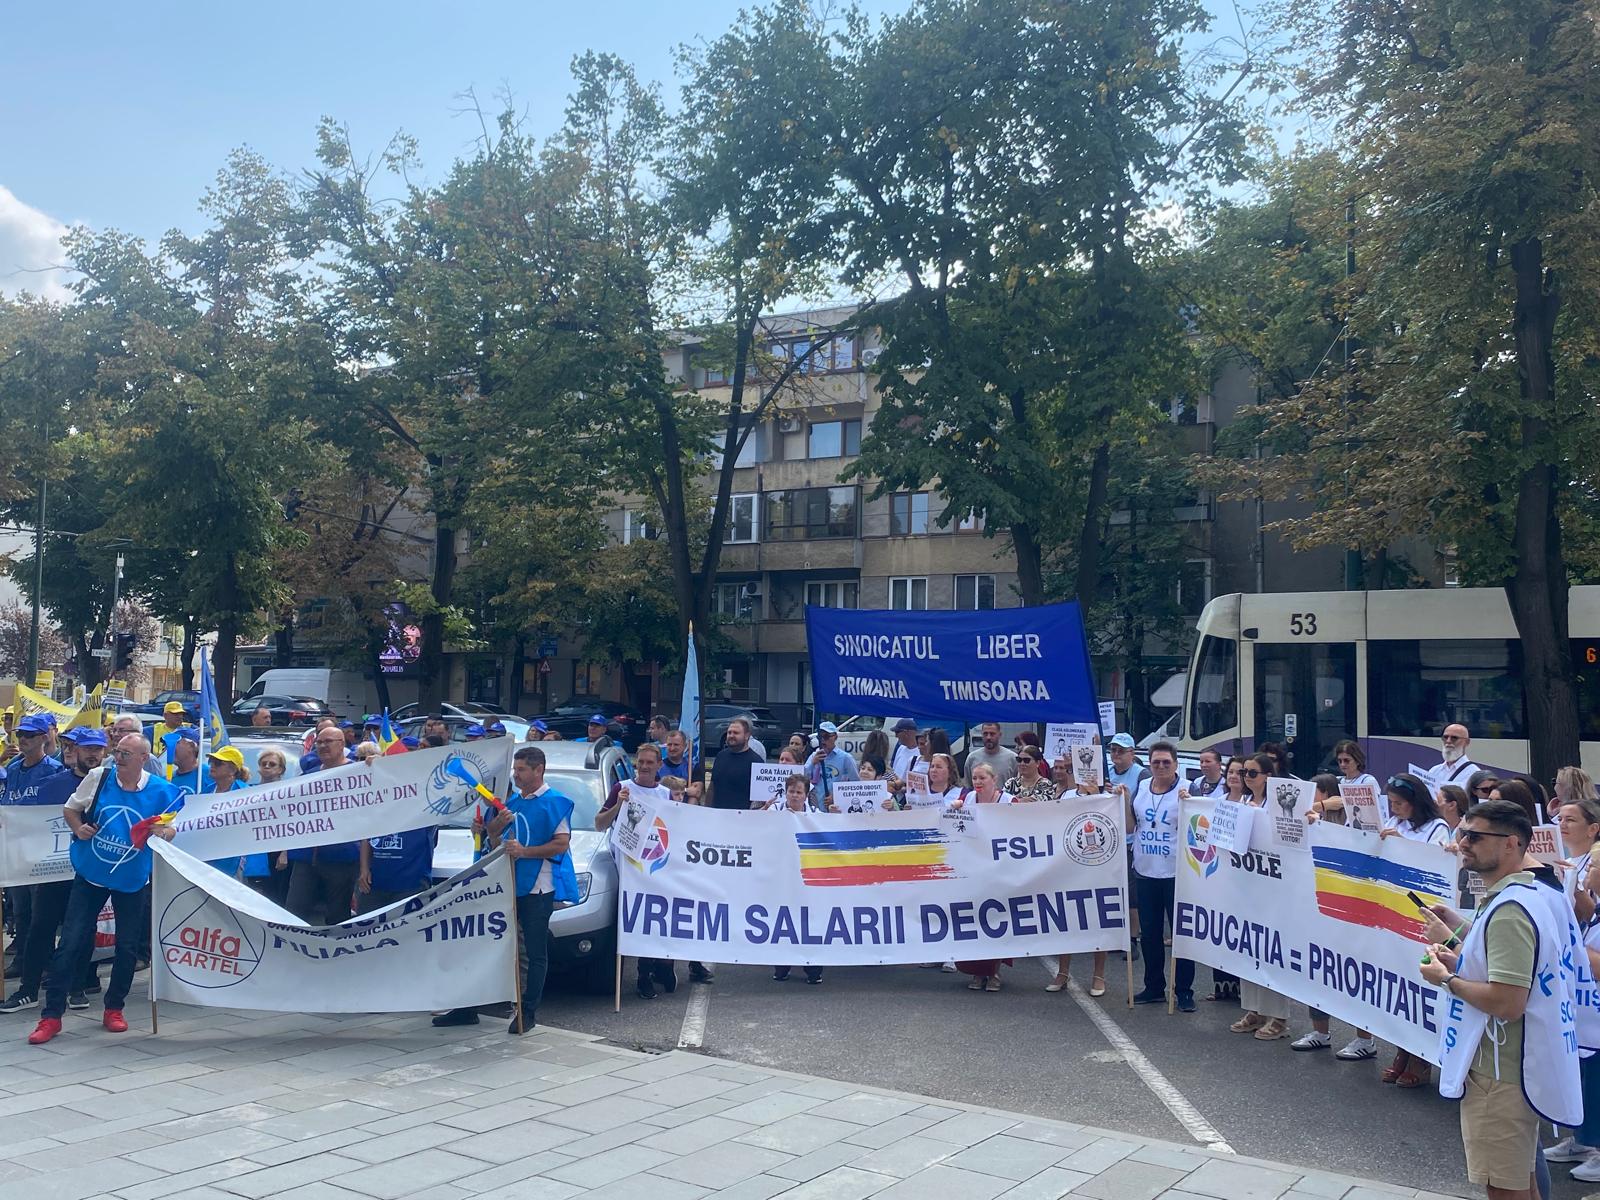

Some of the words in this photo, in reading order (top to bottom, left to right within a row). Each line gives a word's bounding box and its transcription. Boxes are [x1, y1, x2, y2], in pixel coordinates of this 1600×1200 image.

[1290, 613, 1317, 636] 53
[834, 634, 940, 660] SINDICATUL
[976, 633, 1042, 660] LIBER
[839, 676, 910, 700] PRIMARIA
[940, 679, 1051, 702] TIMISOARA
[210, 786, 296, 813] SINDICATUL
[299, 776, 346, 798] LIBER
[346, 772, 374, 791] DIN
[837, 784, 863, 792] PROFESOR
[174, 805, 278, 834] NIVERSITATEA
[280, 788, 389, 818] "POLITEHNICA"
[392, 783, 419, 802] DIN
[252, 816, 335, 842] TIMISOARA
[1141, 830, 1171, 842] SOLE
[1531, 830, 1554, 842] ATIA
[96, 841, 127, 856] CARTEL
[686, 839, 752, 868] SOLE
[991, 834, 1055, 861] FSLI
[1229, 850, 1282, 879] SOLE
[416, 882, 504, 920] TERITORIALĂ
[622, 890, 730, 942] VREM
[744, 903, 905, 945] SALARII
[919, 887, 1125, 943] DECENTE
[180, 927, 241, 958] alfa
[166, 947, 244, 977] CARTEL
[1308, 942, 1439, 1034] PRIORITATE
